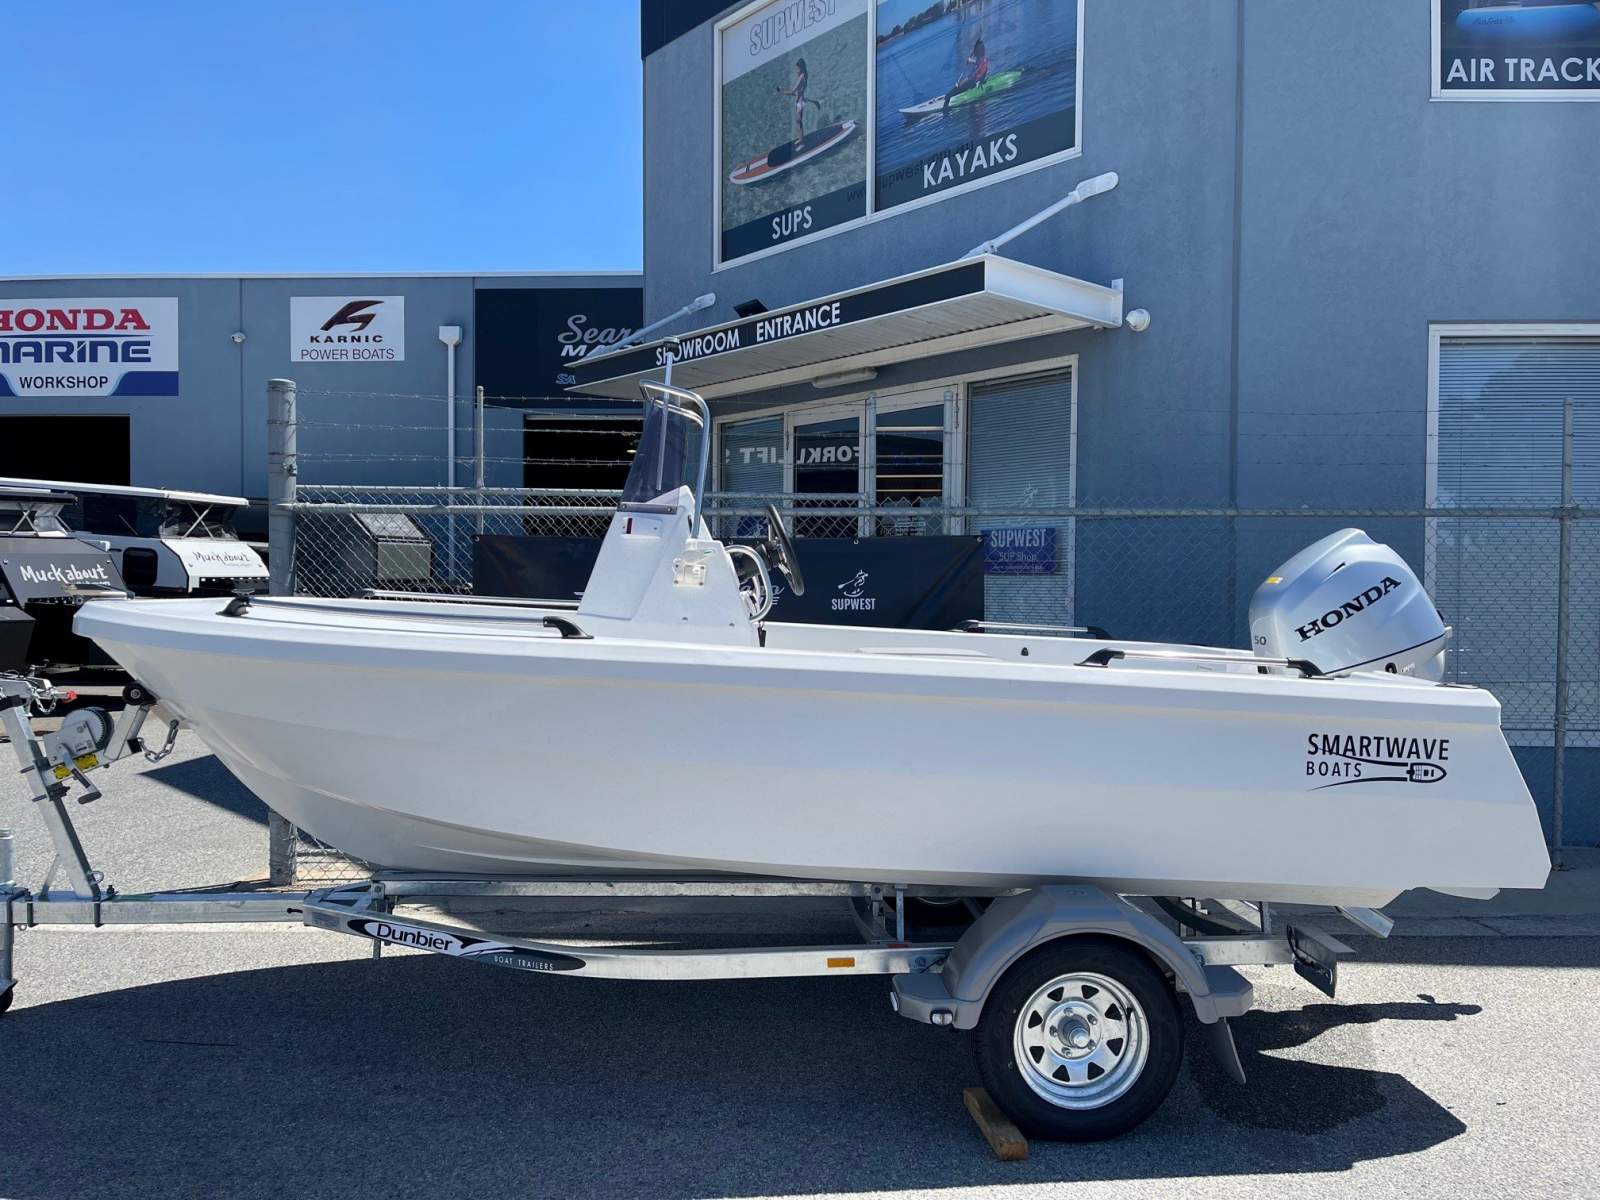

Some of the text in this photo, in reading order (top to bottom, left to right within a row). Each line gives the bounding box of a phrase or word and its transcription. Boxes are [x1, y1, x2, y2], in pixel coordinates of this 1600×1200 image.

[1447, 57, 1600, 83] AIR TRACK
[923, 133, 1018, 189] KAYAKS
[772, 205, 813, 240] SUPS
[756, 302, 841, 342] ENTRANCE
[310, 335, 384, 343] KARNIC
[301, 347, 394, 361] POWER BOATS
[19, 376, 109, 389] WORKSHOP
[991, 528, 1047, 548] SUPWEST
[193, 551, 250, 565] Muckabout
[20, 562, 109, 584] Muckabout
[831, 598, 876, 611] SUPWEST
[1294, 576, 1401, 643] HONDA
[1254, 635, 1267, 646] 50
[1307, 733, 1450, 761] SMARTWAVE
[1306, 760, 1362, 778] BOATS
[377, 923, 453, 951] Dunbier
[494, 955, 554, 971] BOAT TRAILERS
